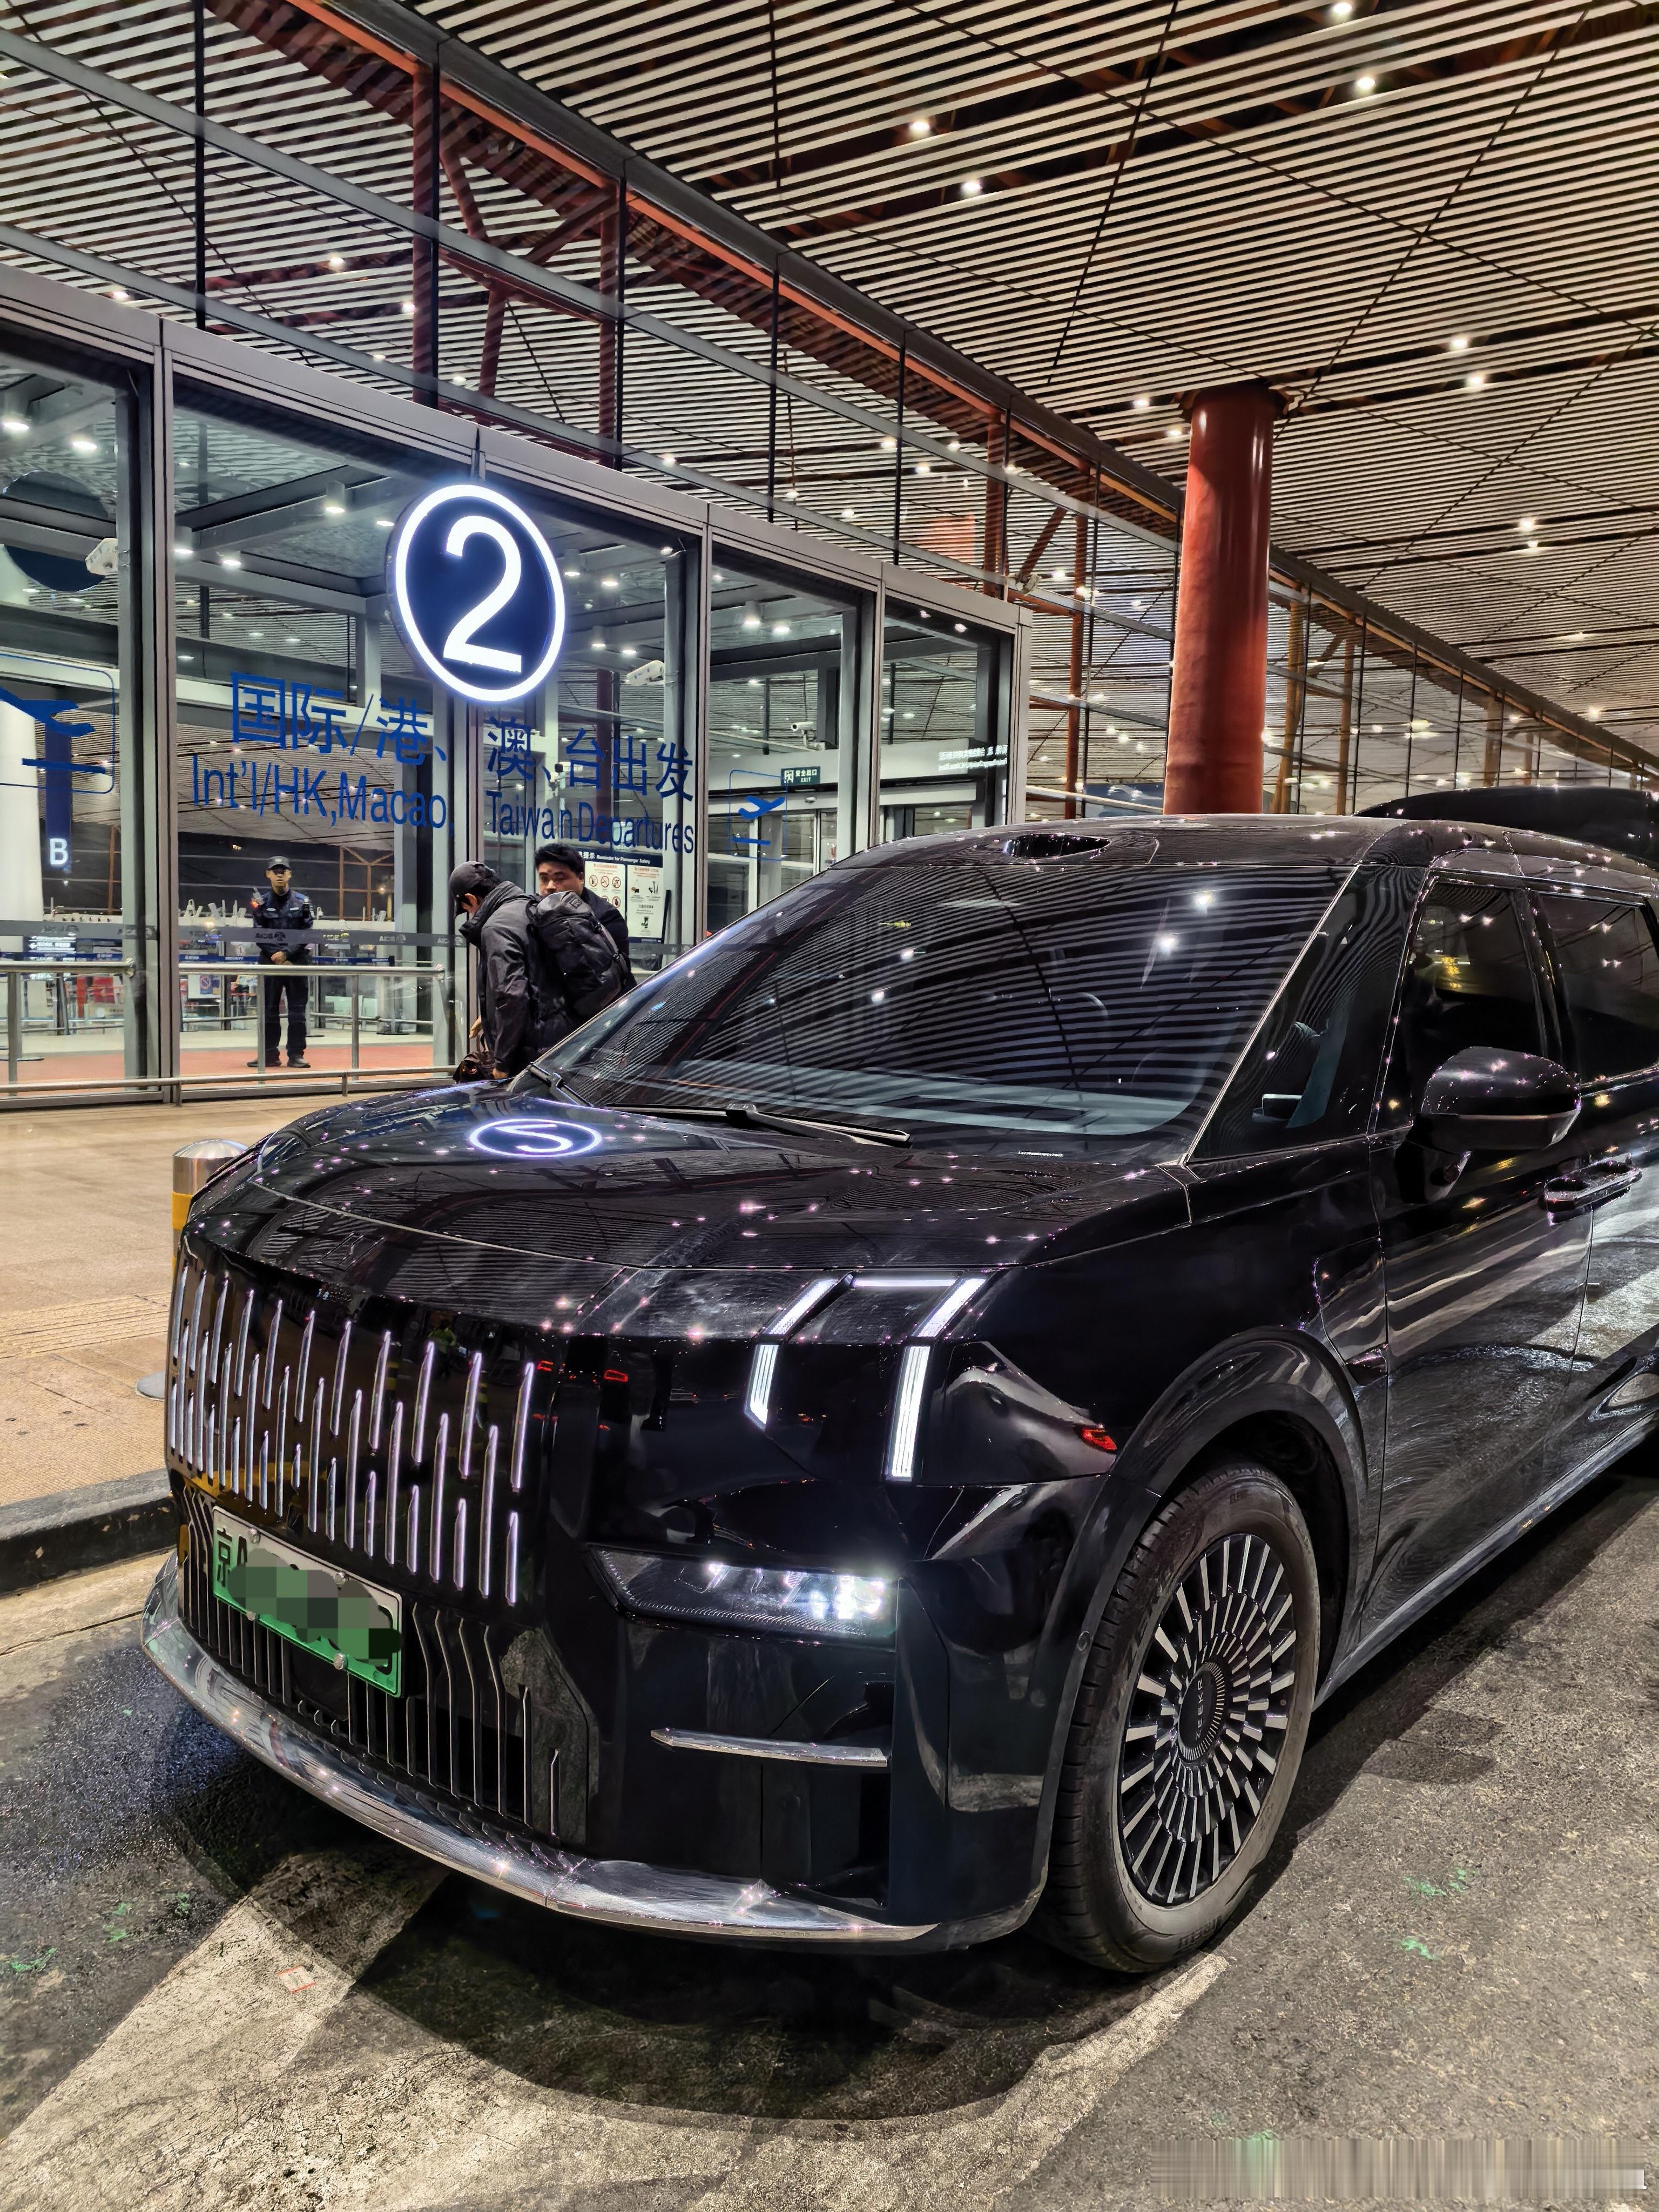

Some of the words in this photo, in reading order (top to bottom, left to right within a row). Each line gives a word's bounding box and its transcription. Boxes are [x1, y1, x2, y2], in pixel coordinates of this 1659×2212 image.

[443, 515, 522, 673] 2
[50, 838, 68, 865] B
[1195, 1678, 1203, 1741] ZEEKR
